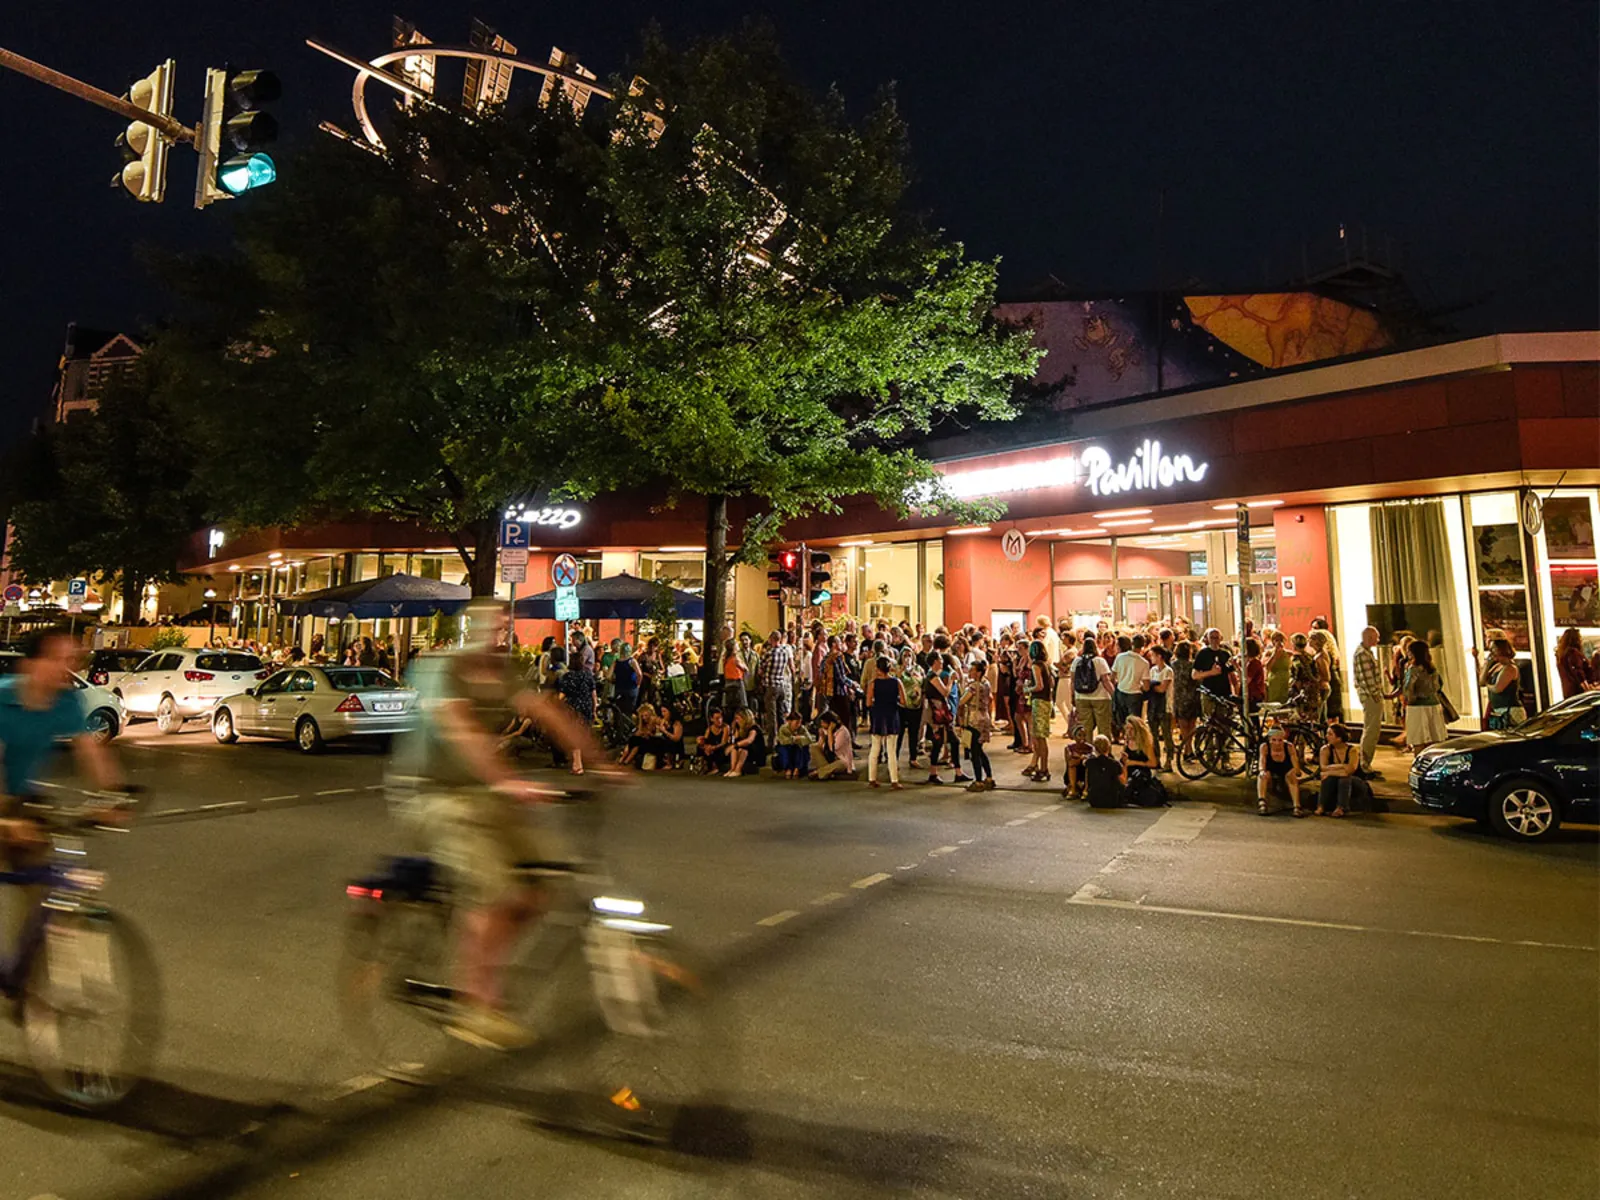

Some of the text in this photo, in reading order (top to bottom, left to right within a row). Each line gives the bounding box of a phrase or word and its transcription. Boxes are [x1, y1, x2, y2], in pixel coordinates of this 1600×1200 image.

[1081, 439, 1208, 496] Pavillon
[505, 523, 521, 545] P
[71, 581, 82, 593] P
